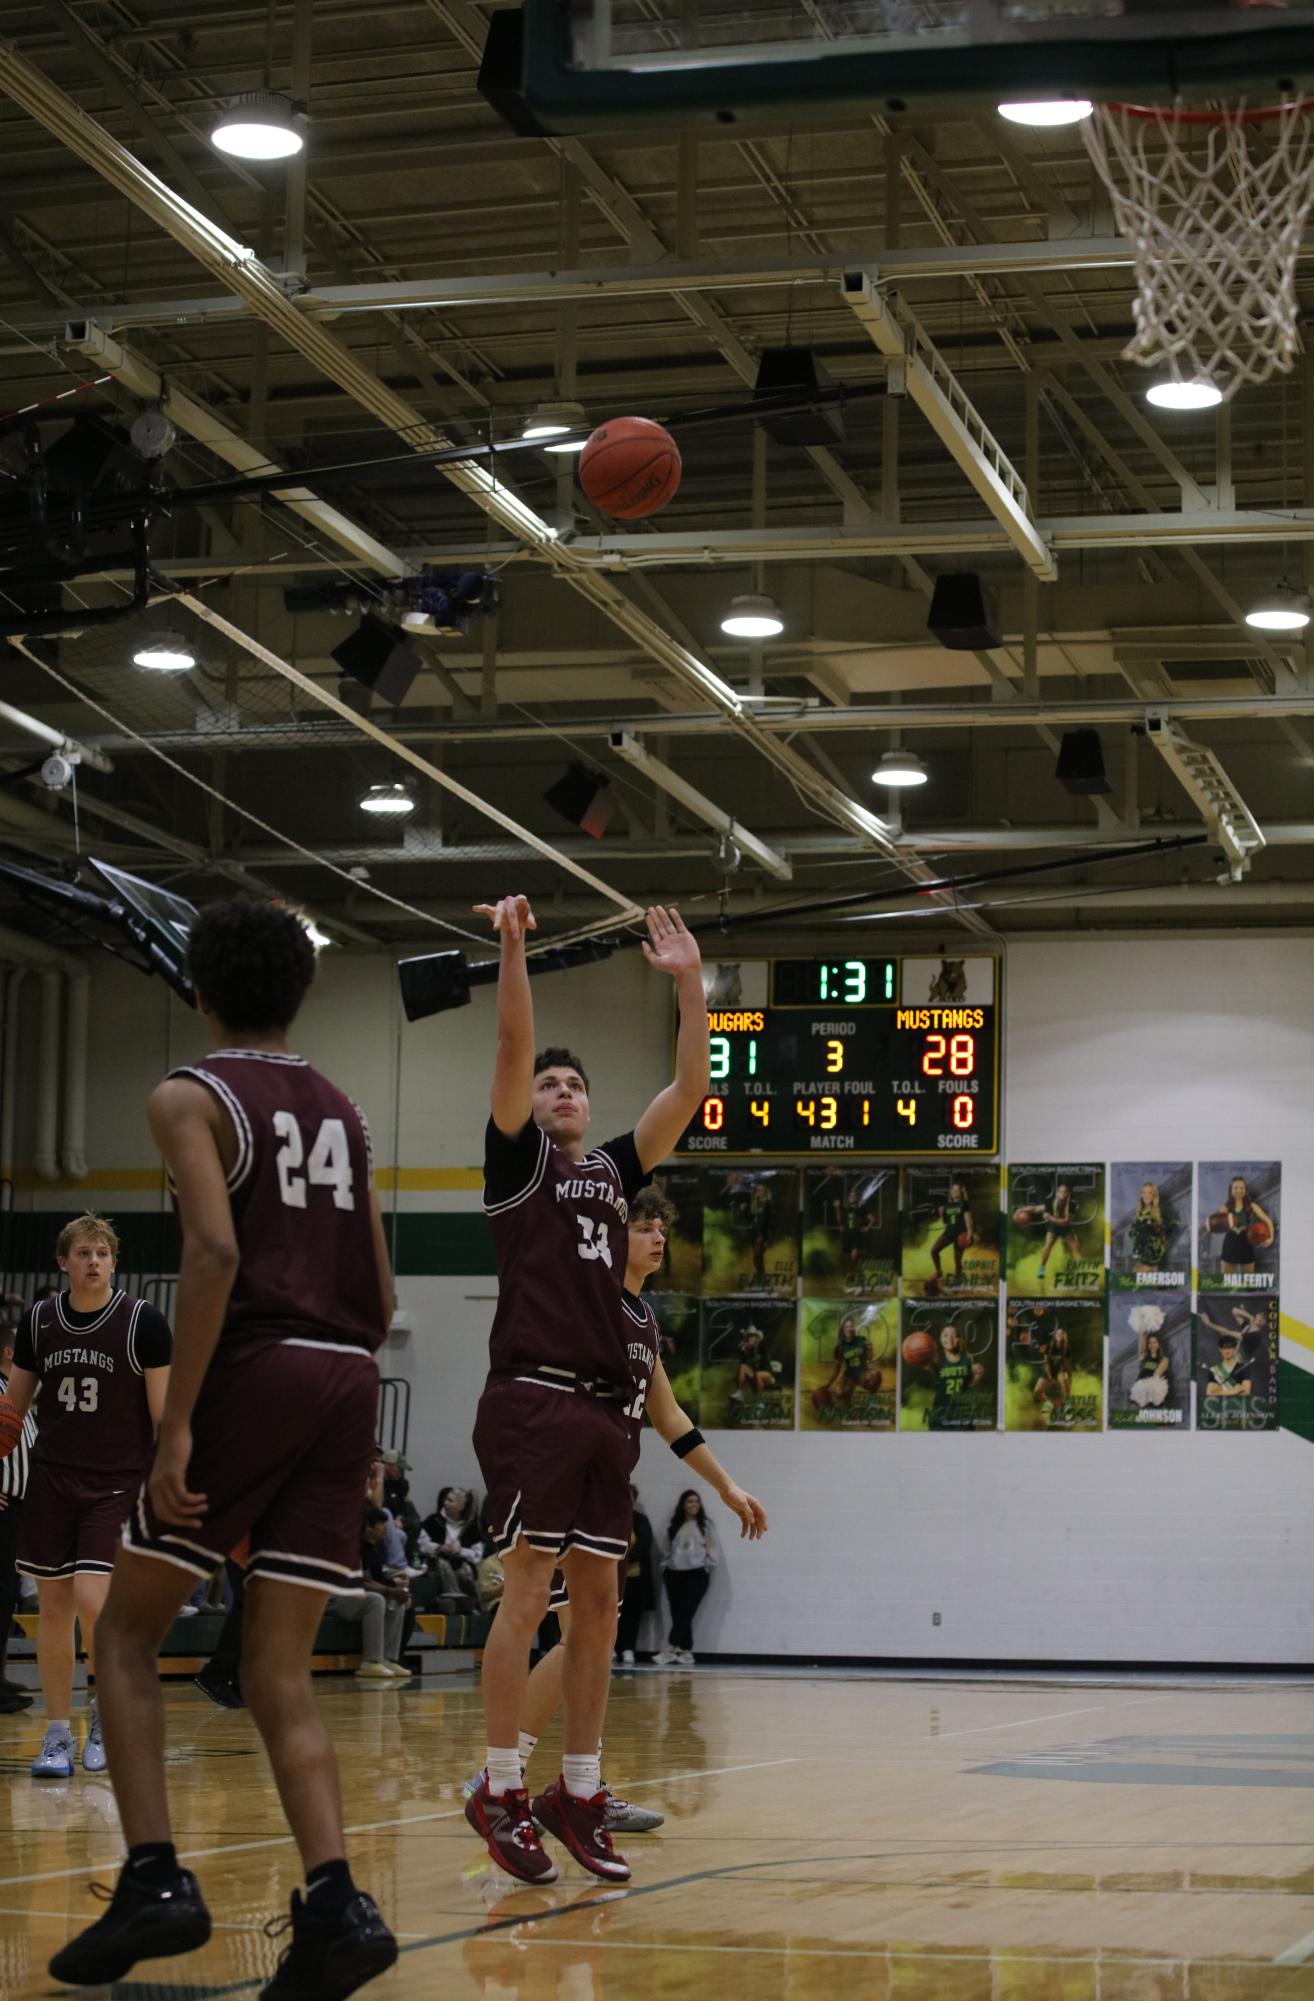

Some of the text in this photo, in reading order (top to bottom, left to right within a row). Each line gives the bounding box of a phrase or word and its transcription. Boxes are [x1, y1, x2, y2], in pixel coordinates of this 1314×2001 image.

[820, 961, 893, 1003] 1:31
[706, 1012, 765, 1032] OUGARS
[811, 1022, 857, 1036] PERIOD
[897, 1009, 984, 1029] MUSTANGS
[710, 1037, 757, 1078] 31
[826, 1040, 844, 1072] 3
[923, 1034, 974, 1075] 28
[706, 1082, 729, 1095] ULS
[744, 1082, 777, 1095] T.O.L.
[793, 1081, 876, 1095] PLAYER FOUL
[892, 1081, 925, 1094] T.O.L.
[938, 1080, 979, 1093] FOULS
[704, 1098, 723, 1130] 0
[750, 1100, 769, 1127] 4
[797, 1097, 870, 1129] 43 1
[897, 1099, 916, 1126] 4
[954, 1095, 973, 1128] 0
[688, 1136, 728, 1150] SCORE
[810, 1136, 854, 1149] MATCH
[938, 1134, 979, 1148] SCORE
[272, 1110, 355, 1211] 24
[1056, 1166, 1102, 1174] BASKETBALL
[555, 1180, 629, 1224] MUSTANGS
[1054, 1272, 1100, 1288] FRITZ
[1136, 1271, 1185, 1286] EMERSON
[1055, 1300, 1101, 1308] BASKETBALL
[44, 1348, 114, 1373] MUSTANGS
[627, 1342, 655, 1375] USTANGS
[1268, 1300, 1278, 1404] COUGAR BAND
[57, 1377, 98, 1412] 43
[1135, 1408, 1183, 1424] JOHNSON
[1202, 1395, 1268, 1429] SHS
